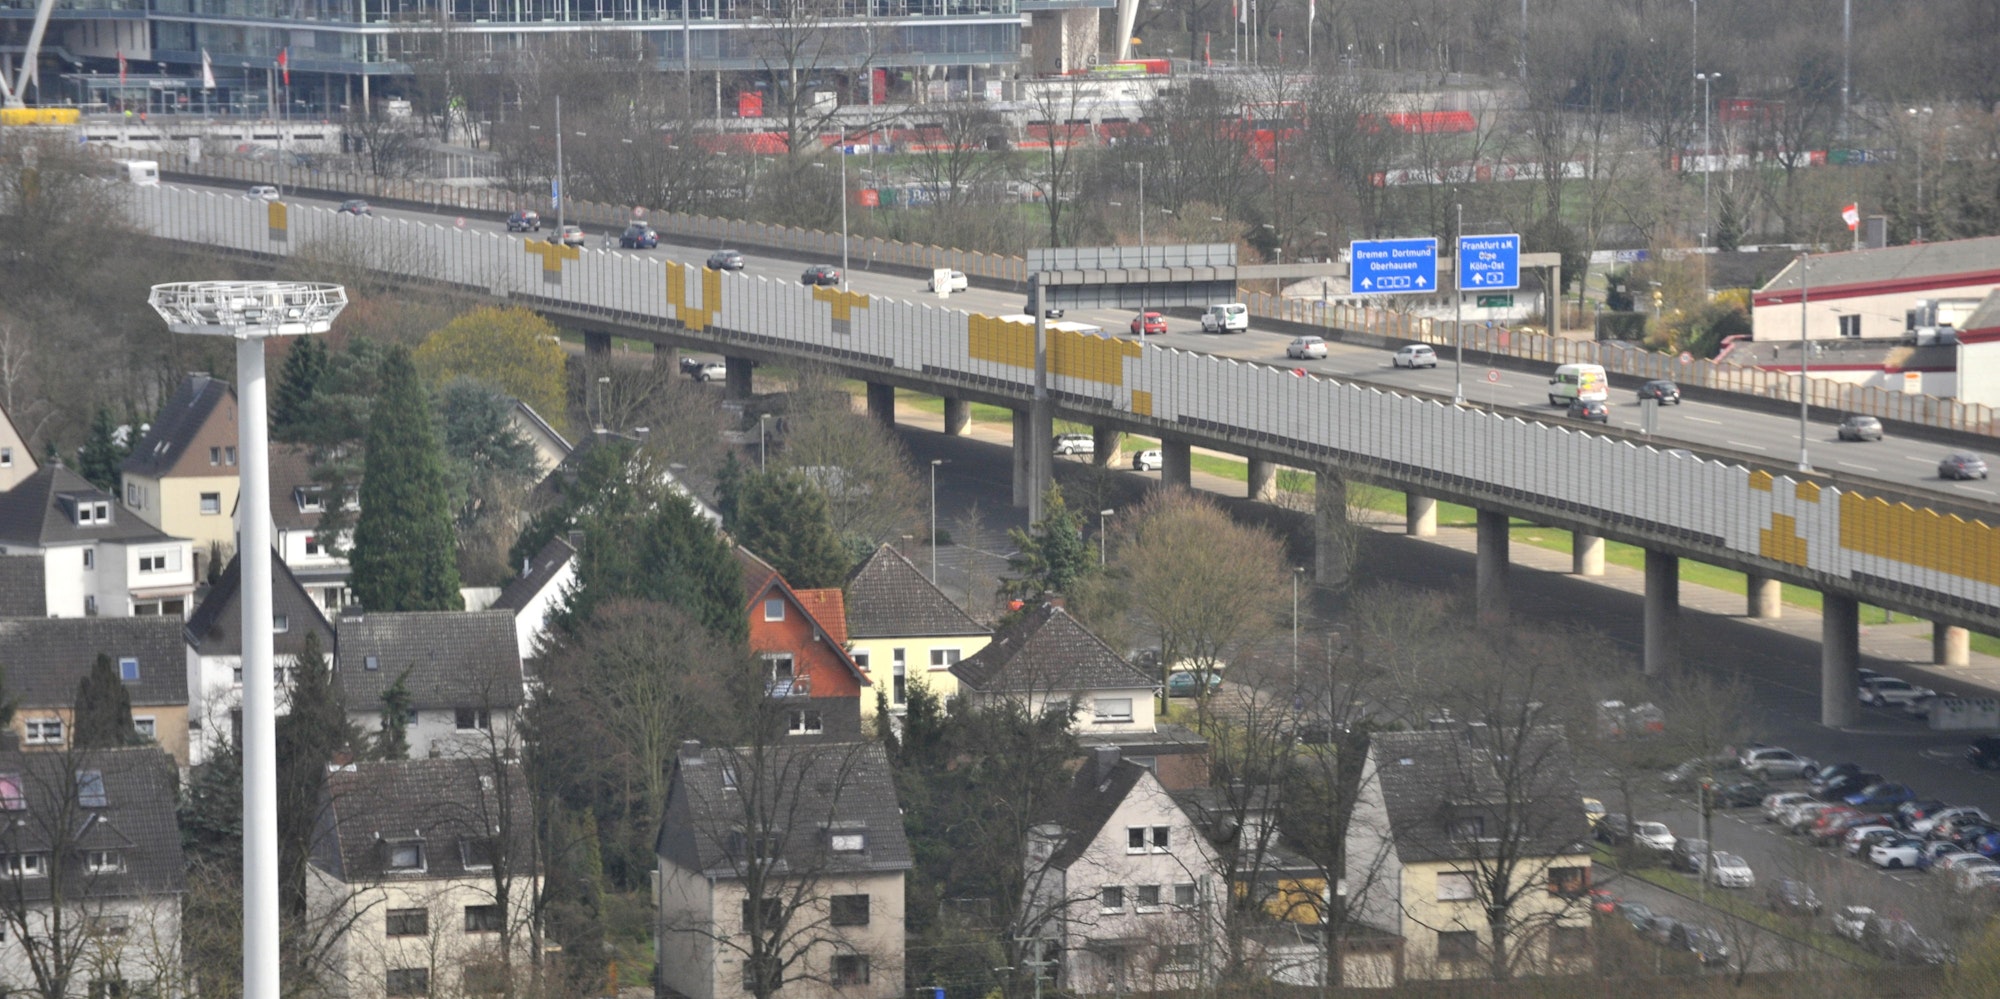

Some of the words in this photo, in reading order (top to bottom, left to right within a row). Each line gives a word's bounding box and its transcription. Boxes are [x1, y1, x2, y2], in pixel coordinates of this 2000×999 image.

[1462, 241, 1499, 250] Frankfurt
[1357, 250, 1388, 260] Bremen
[1392, 248, 1431, 257] Dortmund
[1479, 252, 1497, 261] Olpe
[1370, 262, 1417, 271] Oberhausen
[1470, 262, 1505, 271] Köln-Ost
